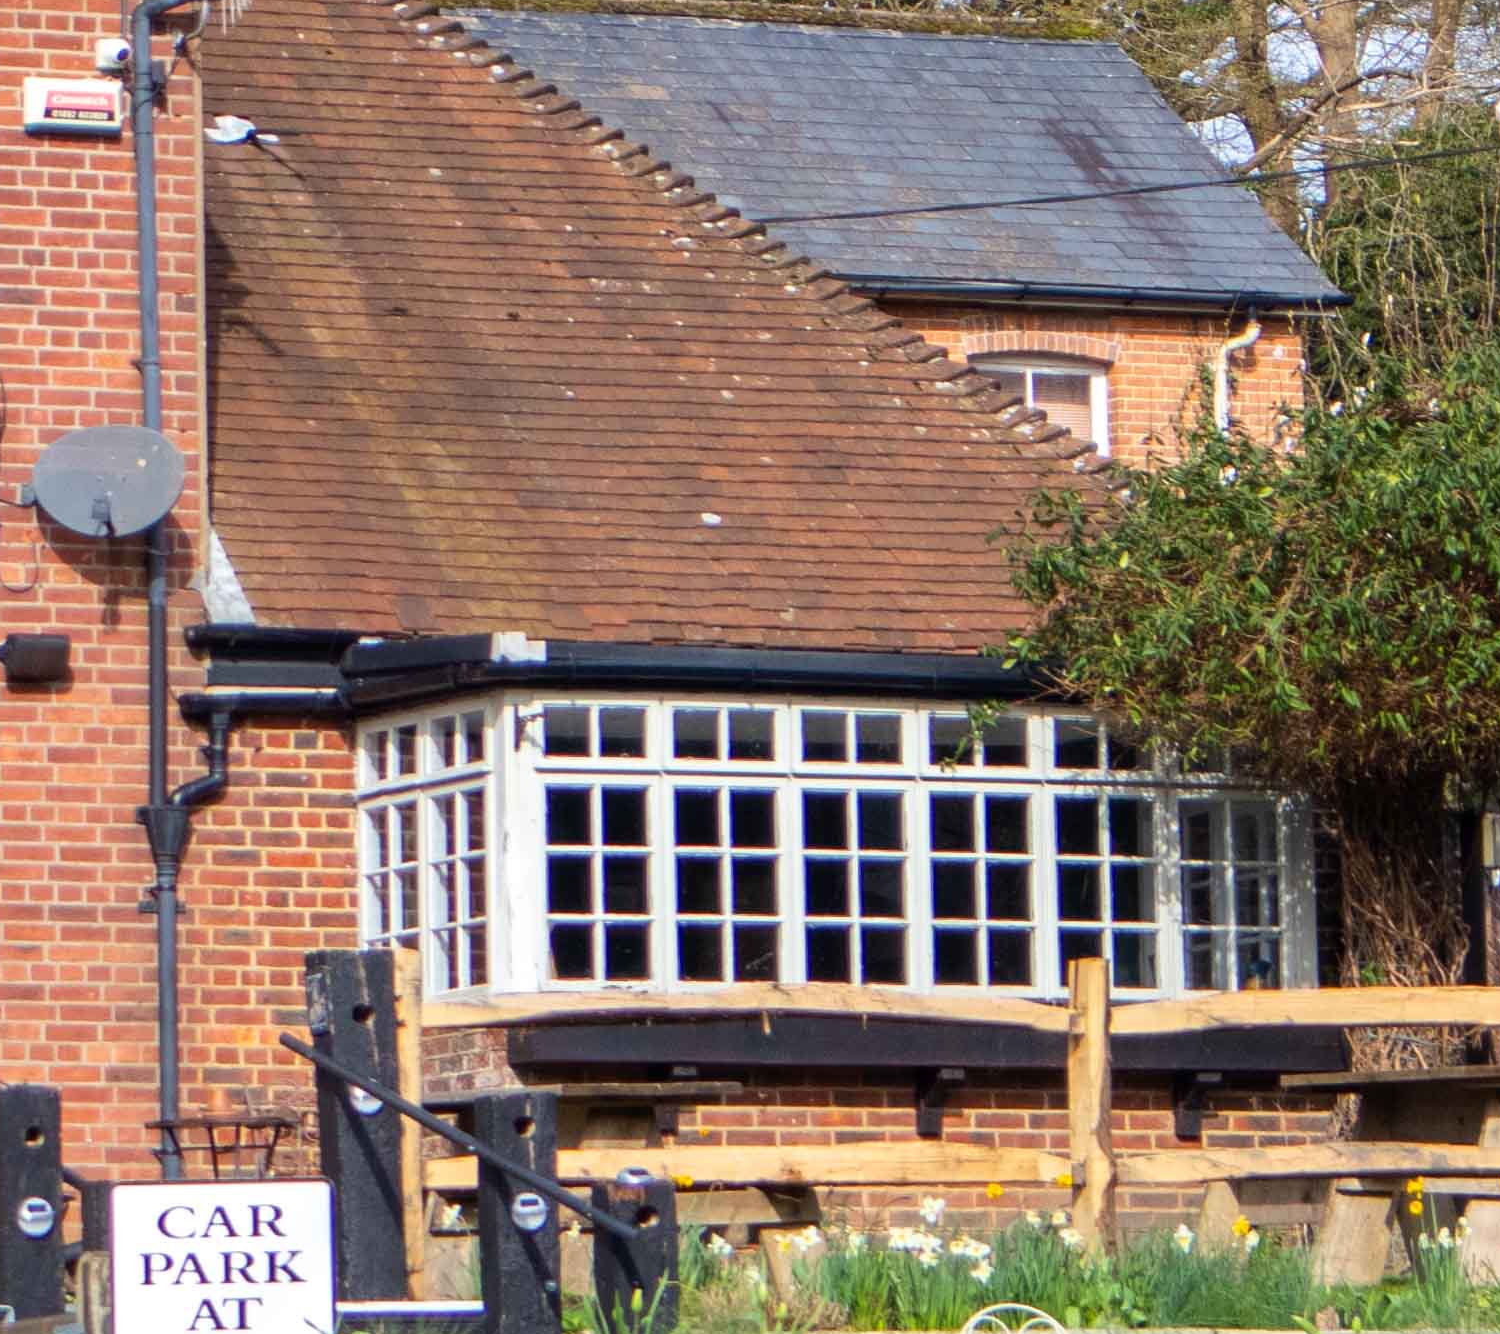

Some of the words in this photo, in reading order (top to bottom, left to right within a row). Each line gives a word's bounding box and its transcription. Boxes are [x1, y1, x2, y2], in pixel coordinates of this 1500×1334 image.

[157, 1204, 287, 1239] CAR
[139, 1250, 308, 1285] PARK
[185, 1297, 263, 1331] AT
